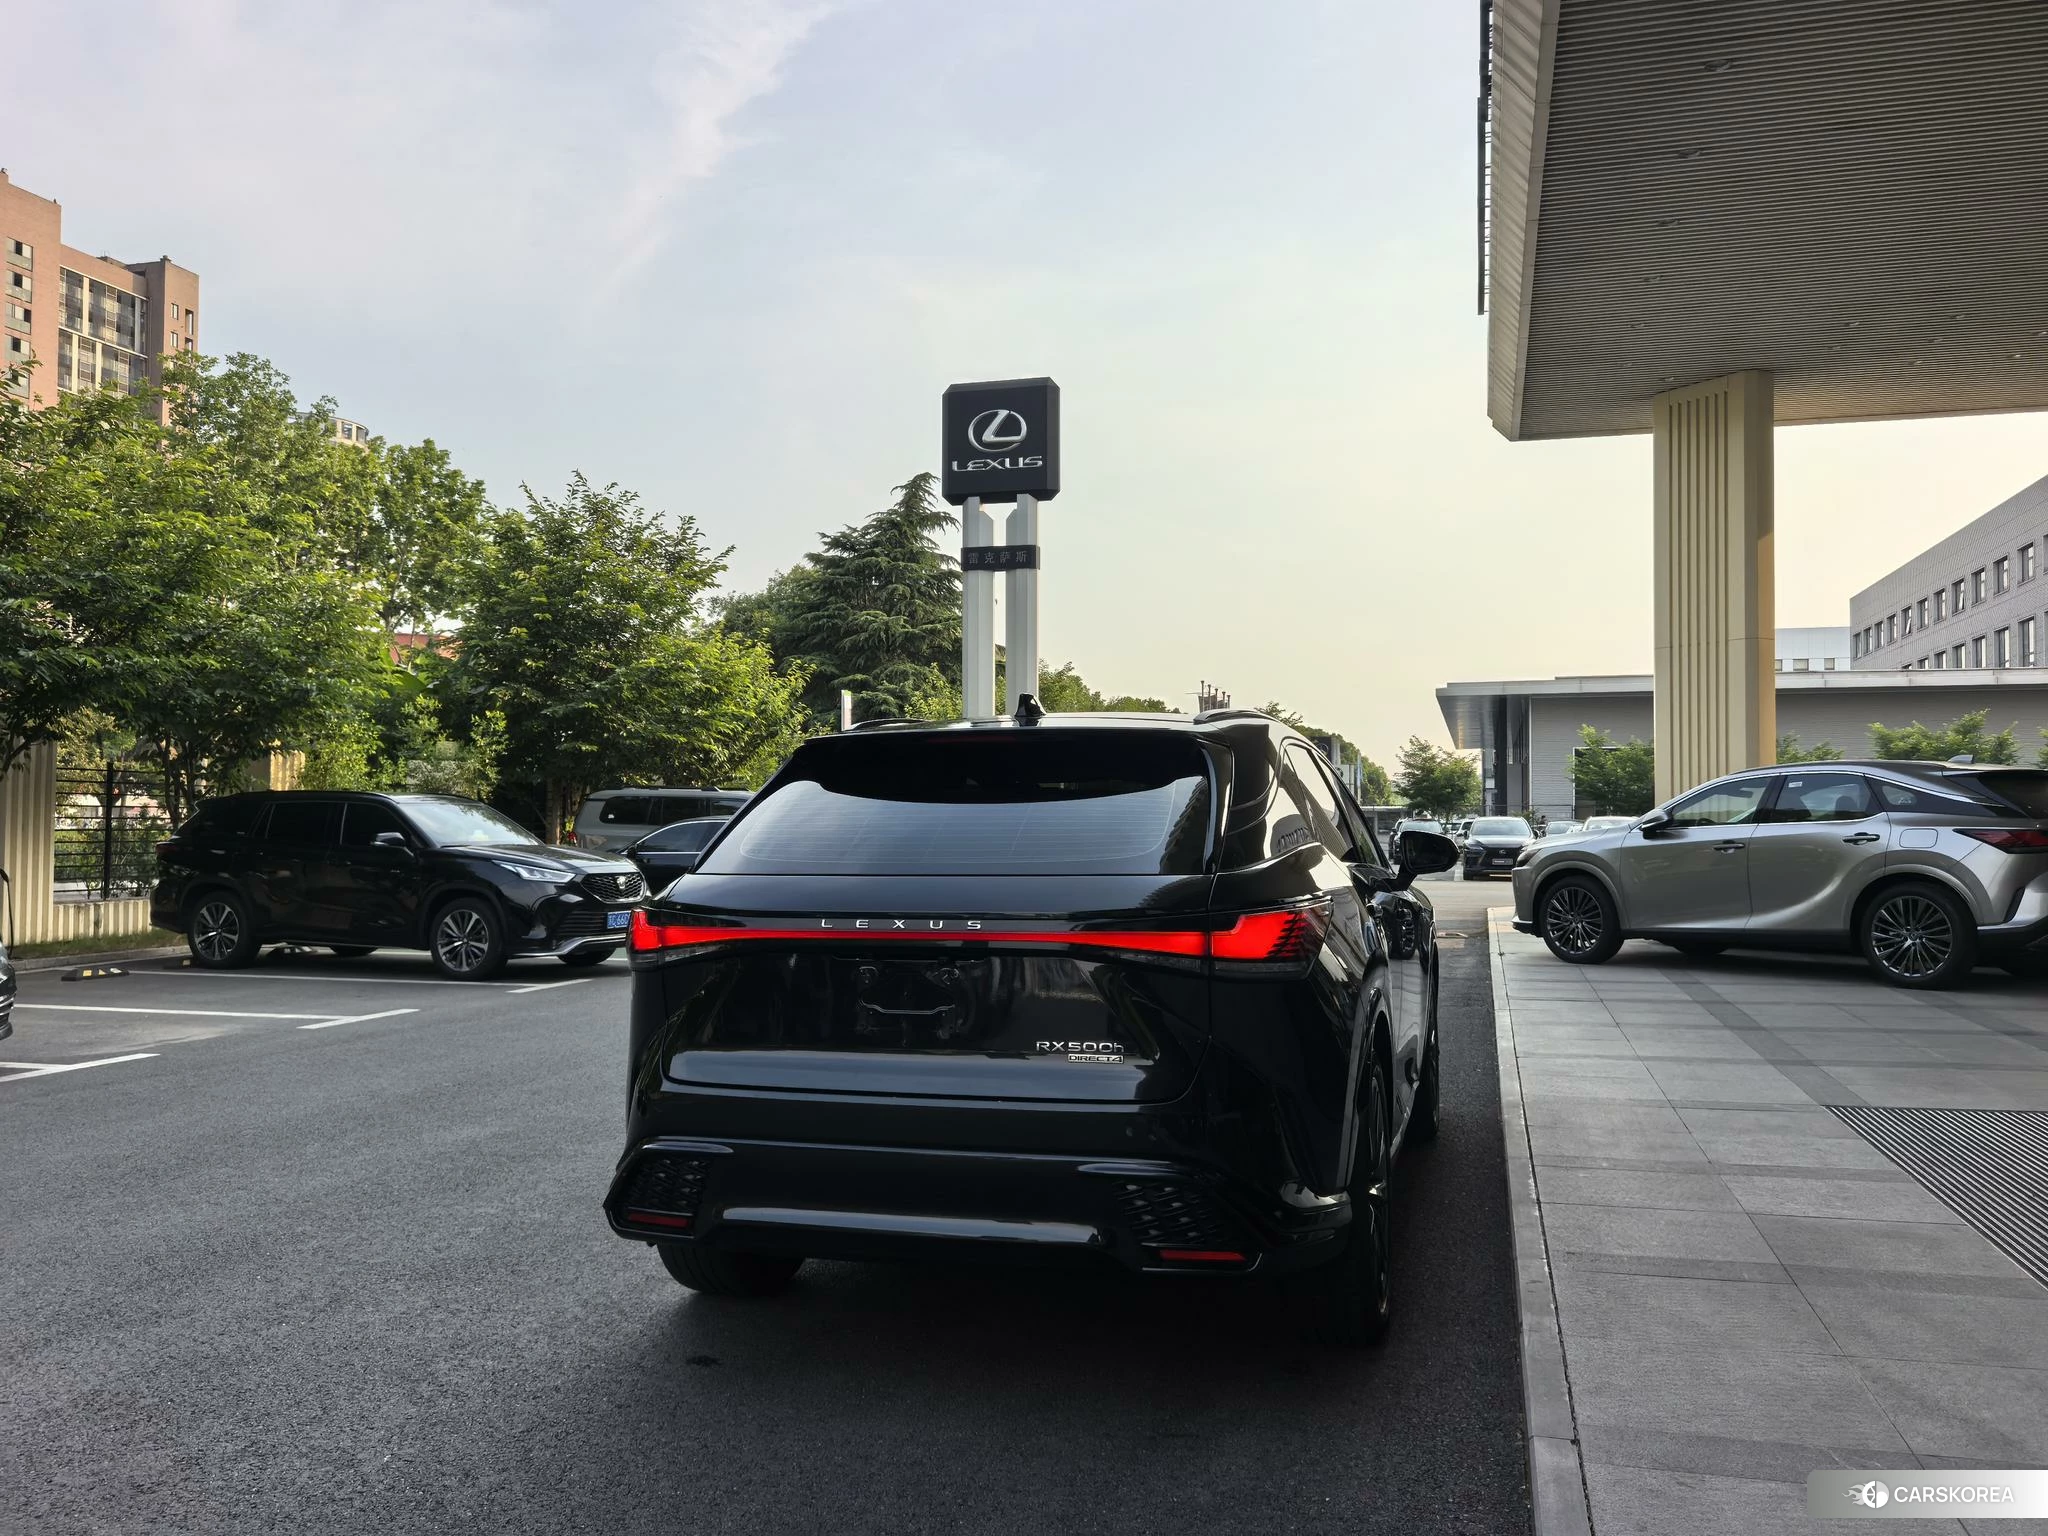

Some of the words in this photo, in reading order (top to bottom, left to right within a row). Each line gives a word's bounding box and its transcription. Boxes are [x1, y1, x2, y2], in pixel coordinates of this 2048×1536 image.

[952, 455, 1043, 472] LEXUS
[967, 550, 1028, 565] 雷克萨斯
[821, 918, 981, 930] LEXUS
[1068, 1054, 1123, 1063] DIRECT4
